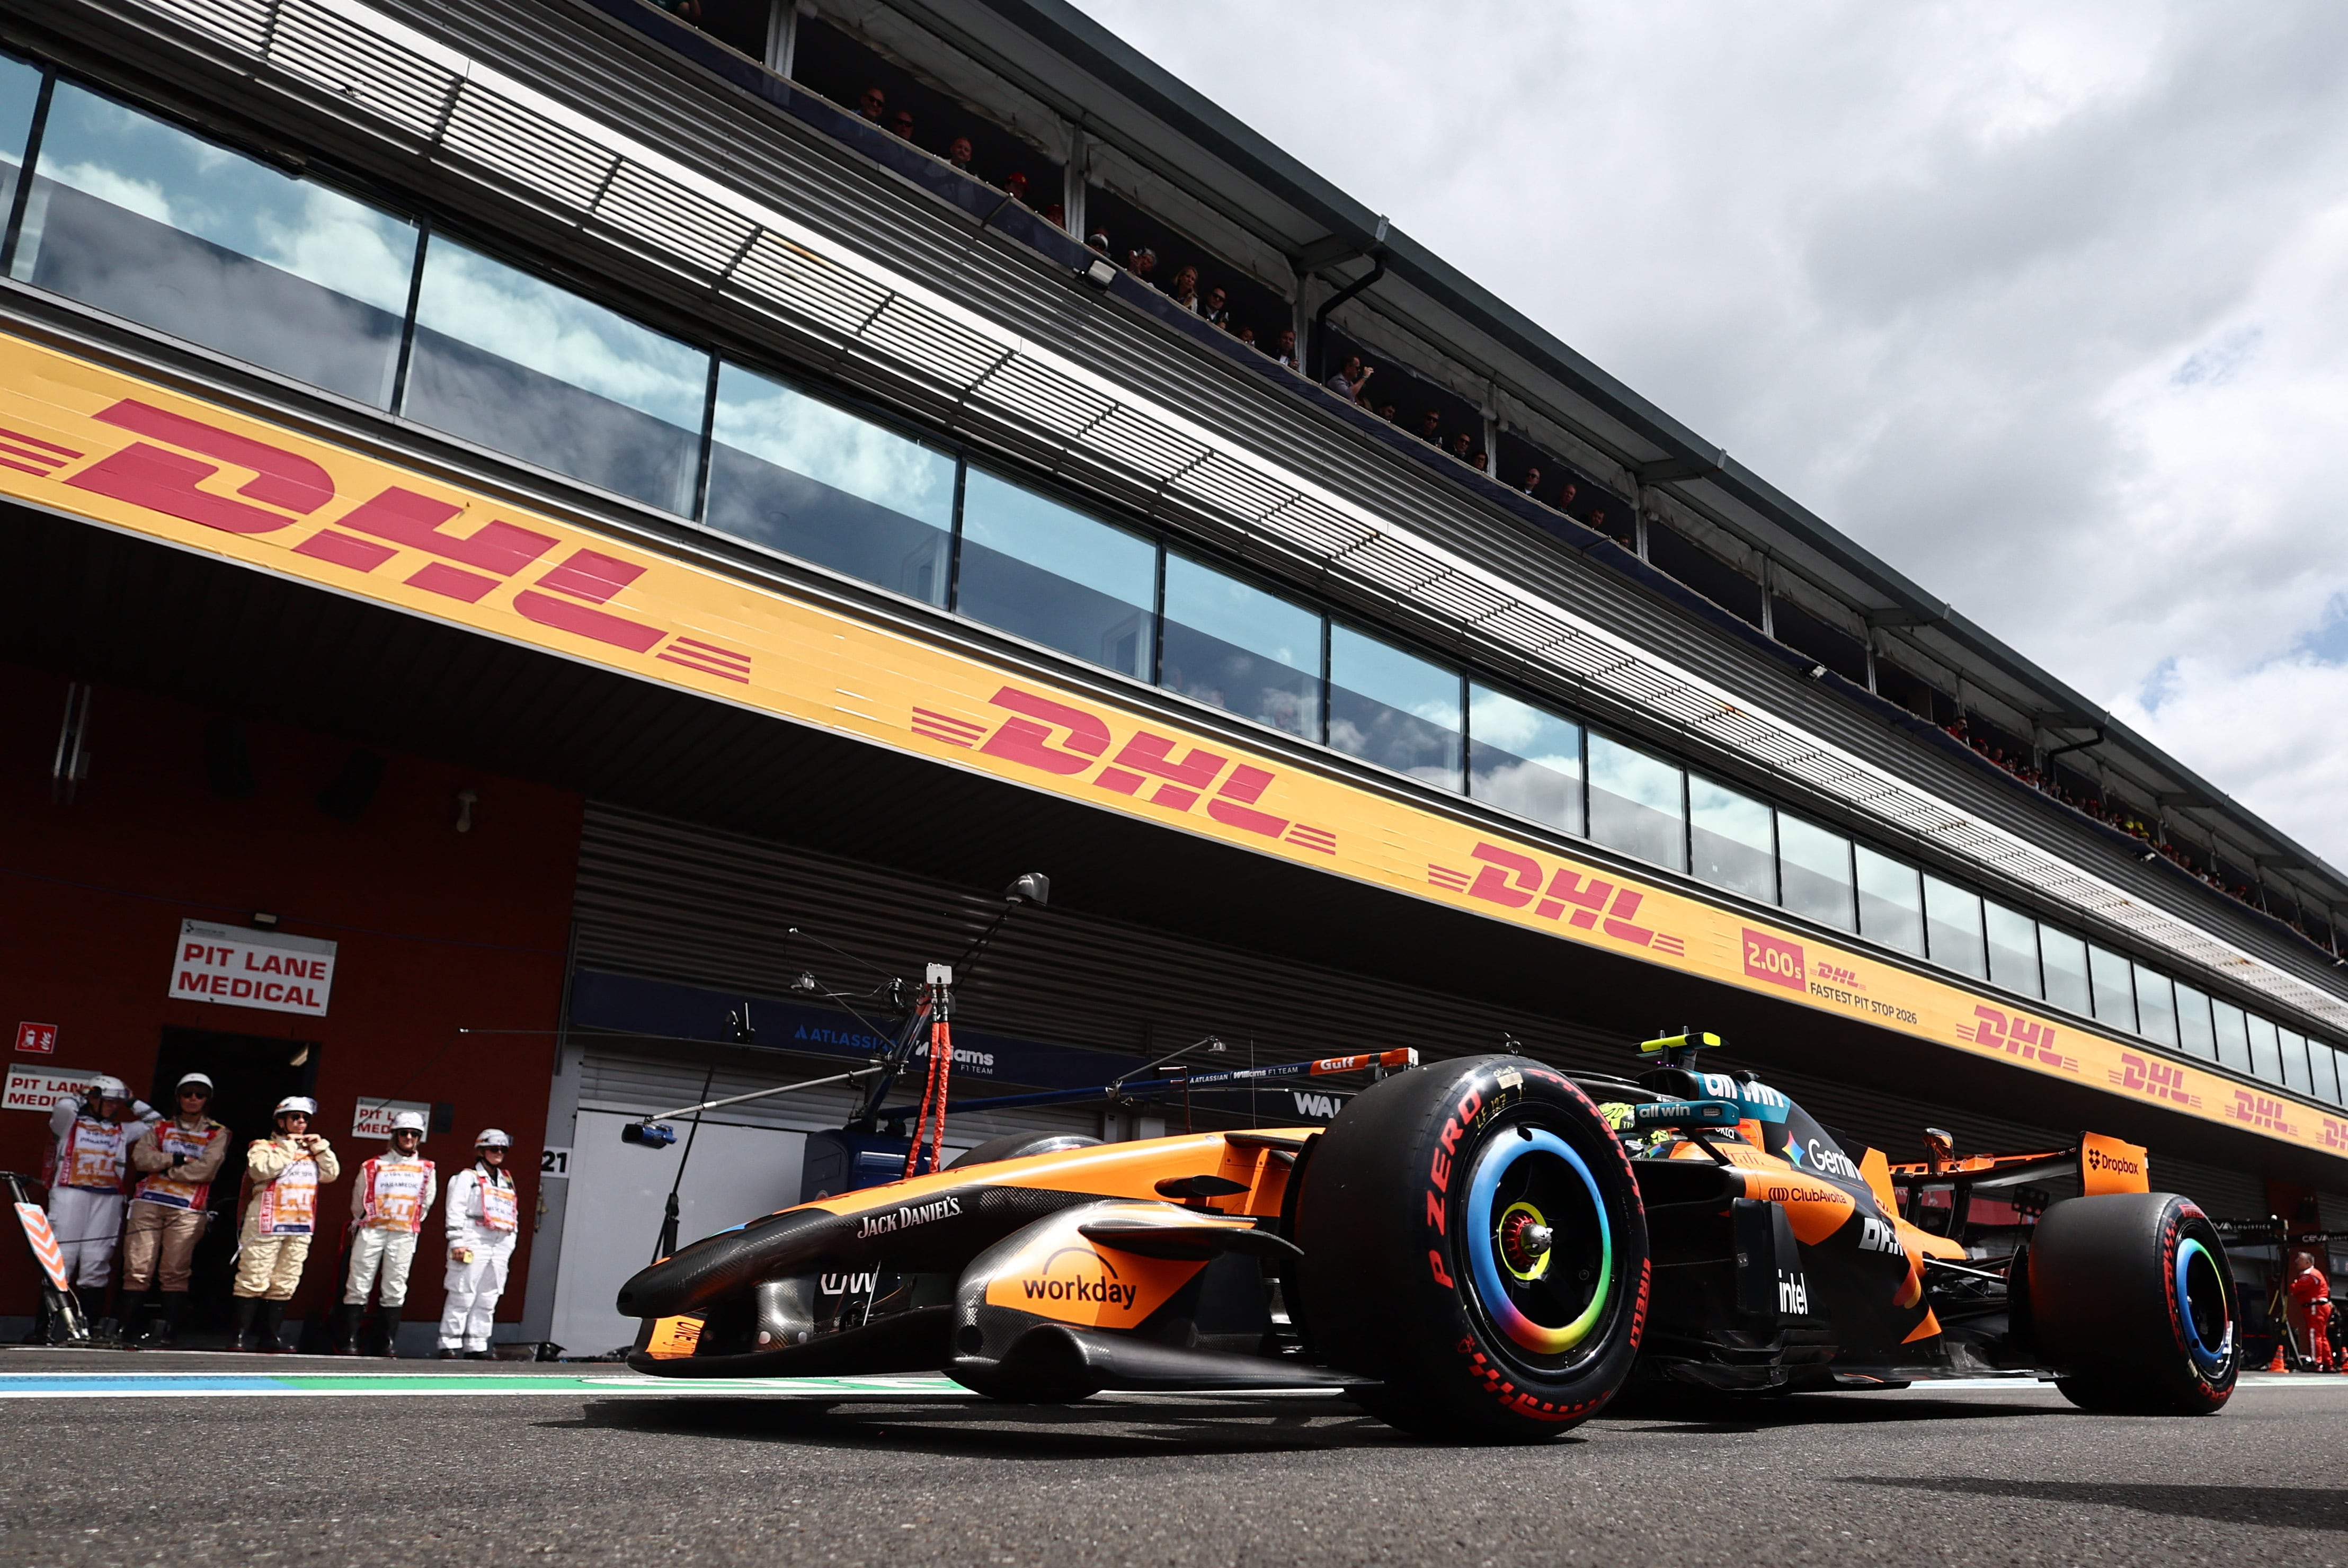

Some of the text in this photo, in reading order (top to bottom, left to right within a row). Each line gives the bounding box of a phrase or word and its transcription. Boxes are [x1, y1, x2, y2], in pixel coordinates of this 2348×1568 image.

[62, 397, 670, 654] DHL
[979, 685, 1290, 839] DHL
[1468, 841, 1653, 947] DHL
[183, 943, 327, 981] PIT LANE
[1818, 961, 1860, 988] DHL
[178, 971, 321, 1008] MEDICAL
[1810, 982, 1918, 1024] FASTEST PIT STOP 2026
[1974, 1004, 2064, 1068] DHL
[960, 1064, 993, 1075] F1 TEAM
[1195, 1073, 1229, 1083] ATLASSIAN
[1233, 1070, 1267, 1080] Williams
[1277, 1066, 1298, 1075] TEAM
[1320, 1056, 1355, 1071] Gulf
[2121, 1052, 2190, 1103] DHL
[11, 1077, 86, 1093] PIT LAN
[359, 1108, 383, 1121] PIT
[1639, 1104, 1691, 1119] all win
[2234, 1090, 2288, 1133] DHL
[2323, 1118, 2348, 1150] DH
[540, 1150, 567, 1173] 21
[1426, 1087, 1482, 1236] ZERO
[2102, 1154, 2139, 1175] Dropbox
[1791, 1187, 1848, 1205] ClubAvolta
[857, 1213, 897, 1239] JACK
[2302, 1234, 2329, 1243] CEVA
[1022, 1274, 1137, 1311] workday
[1778, 1268, 1808, 1315] intel
